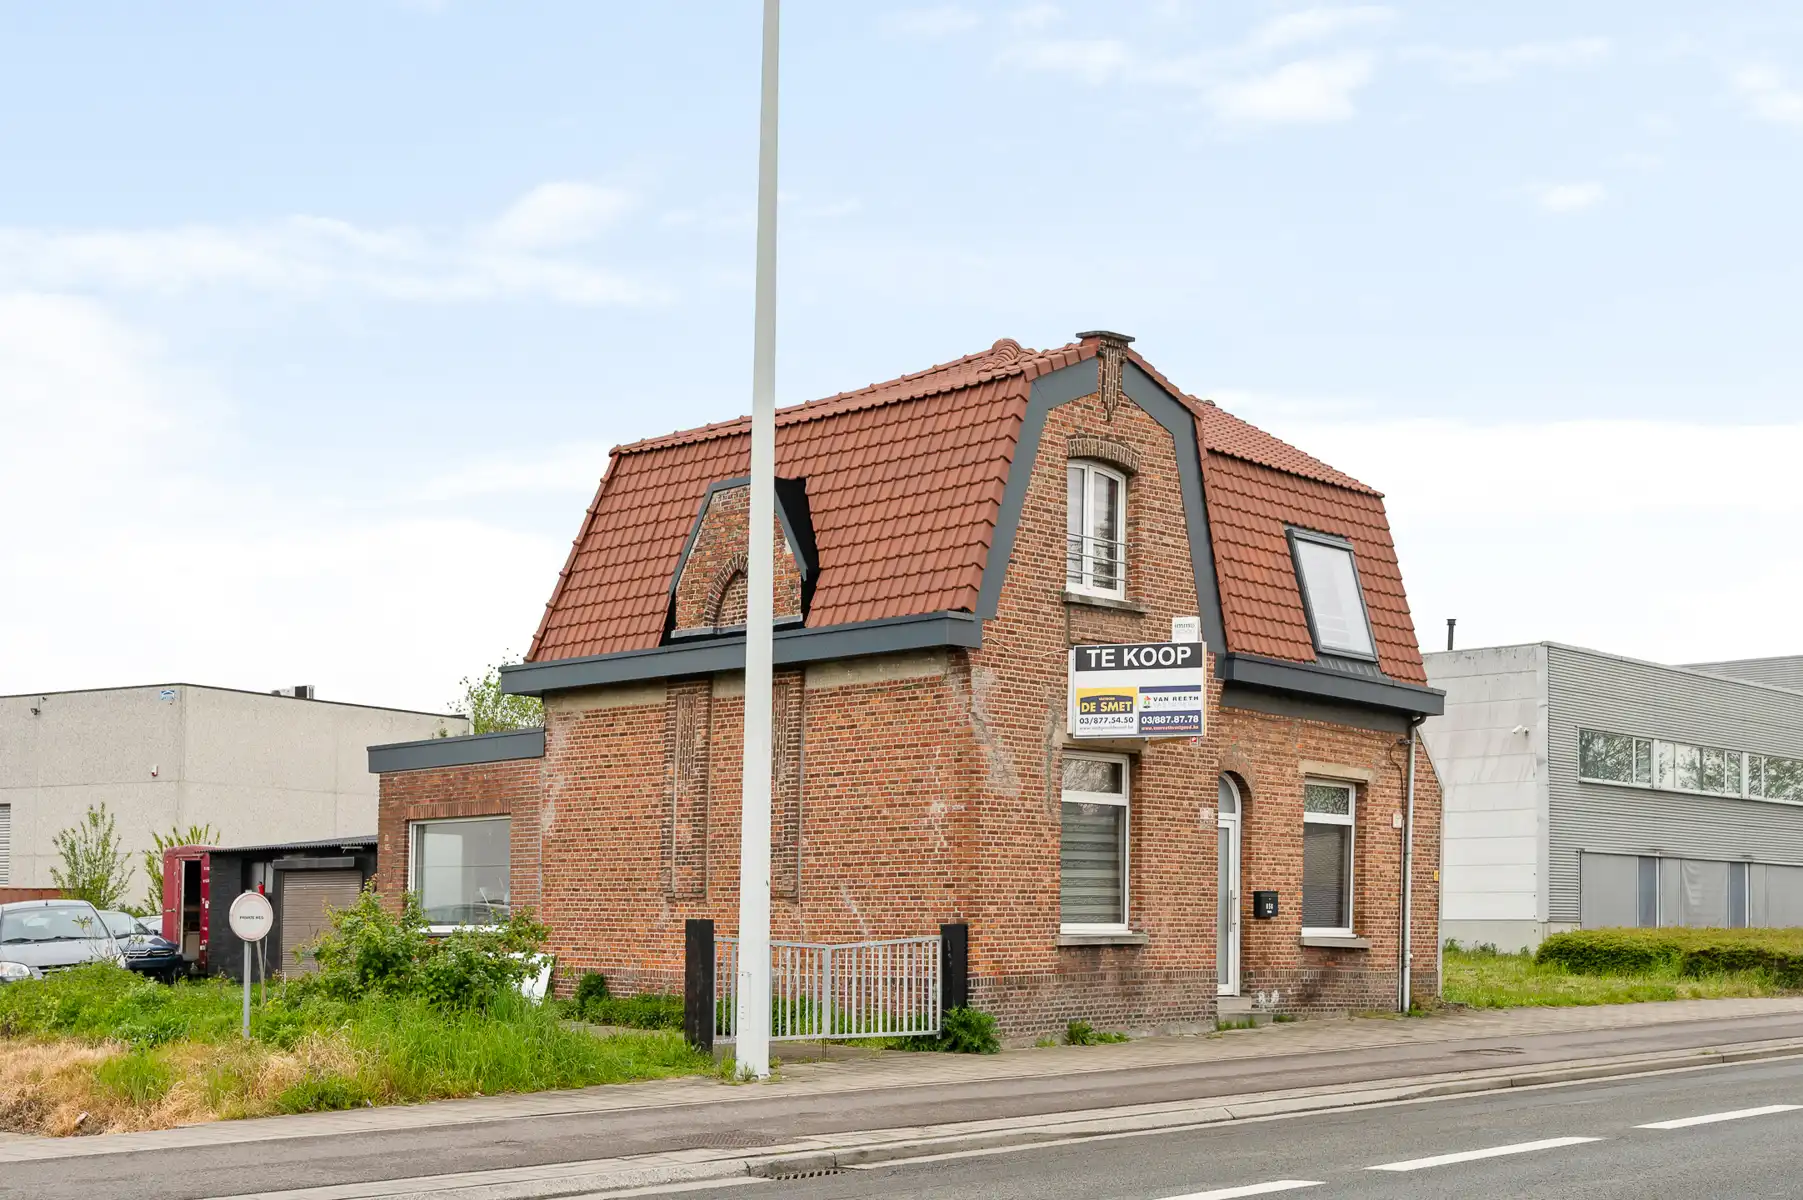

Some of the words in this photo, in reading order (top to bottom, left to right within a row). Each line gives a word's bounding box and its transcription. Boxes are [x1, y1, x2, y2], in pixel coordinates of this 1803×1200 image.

[1086, 648, 1116, 668] TE
[1123, 646, 1192, 667] KOOP
[1081, 702, 1097, 713] DE
[1100, 701, 1132, 712] SMET
[1079, 717, 1134, 725] 03/877.54.50
[1141, 715, 1199, 724] 03/887.87.78
